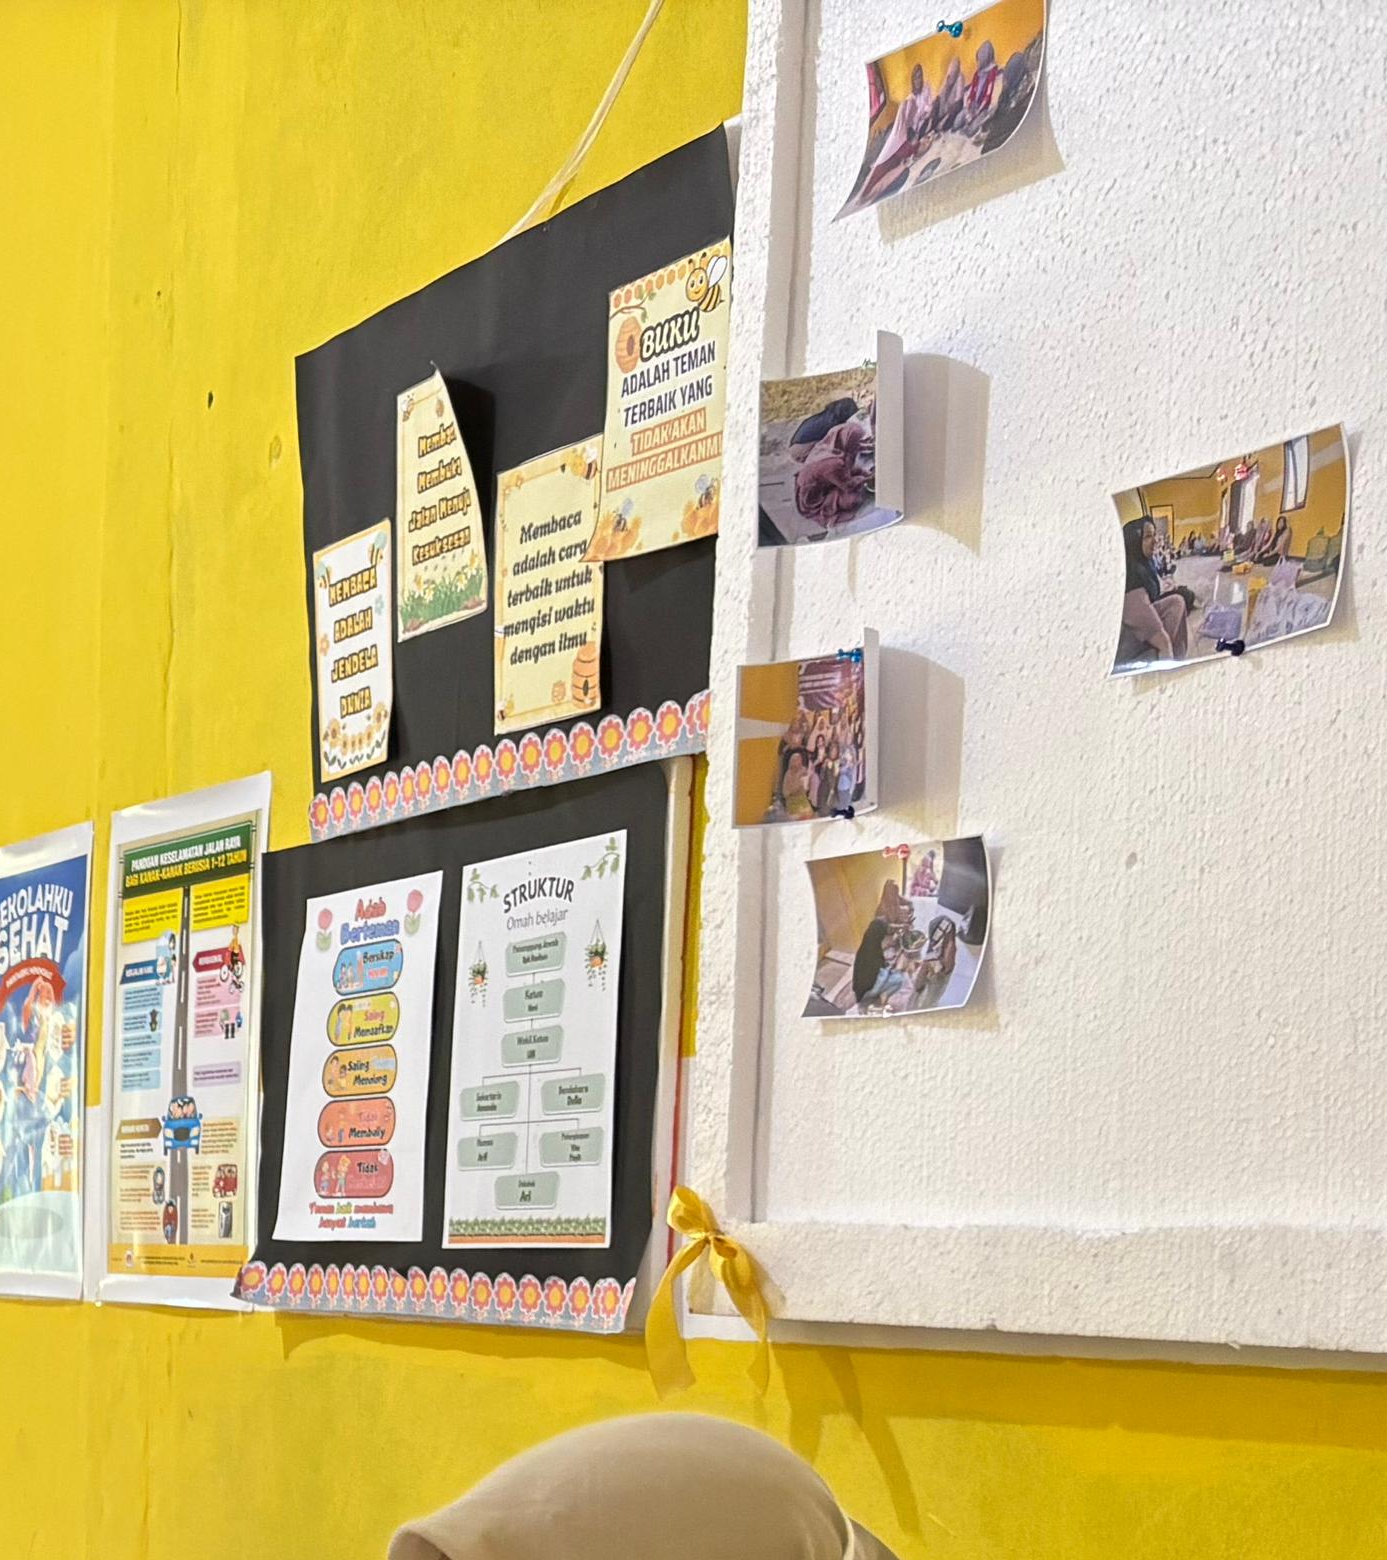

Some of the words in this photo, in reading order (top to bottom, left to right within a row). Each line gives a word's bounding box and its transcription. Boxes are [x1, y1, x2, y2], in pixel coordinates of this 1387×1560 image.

[641, 307, 700, 361] BUKU
[621, 360, 670, 398] ADALAH
[673, 341, 715, 376] TEMAN
[624, 390, 677, 427] TERBAIK
[680, 375, 712, 406] YANG
[633, 424, 671, 454] TIDAK
[671, 411, 706, 443] AKAN
[408, 505, 437, 532] Jalan
[520, 510, 582, 544] Membaca
[412, 526, 471, 566] Kesuksesan
[513, 546, 556, 576] adalah
[558, 540, 588, 561] cara
[329, 567, 377, 608] MEMBACA
[507, 578, 553, 608] terbaik
[555, 565, 593, 593] untuk
[334, 606, 373, 643] ADALAH
[503, 606, 553, 637] mengisi
[555, 597, 595, 623] waktu
[331, 644, 378, 683] JENDELA
[510, 638, 556, 665] dengan
[558, 631, 587, 653] ilmu
[340, 686, 372, 718] DUNIA
[503, 877, 575, 914] STRUKTUR
[506, 912, 534, 931] Omah
[535, 908, 568, 929] belajar
